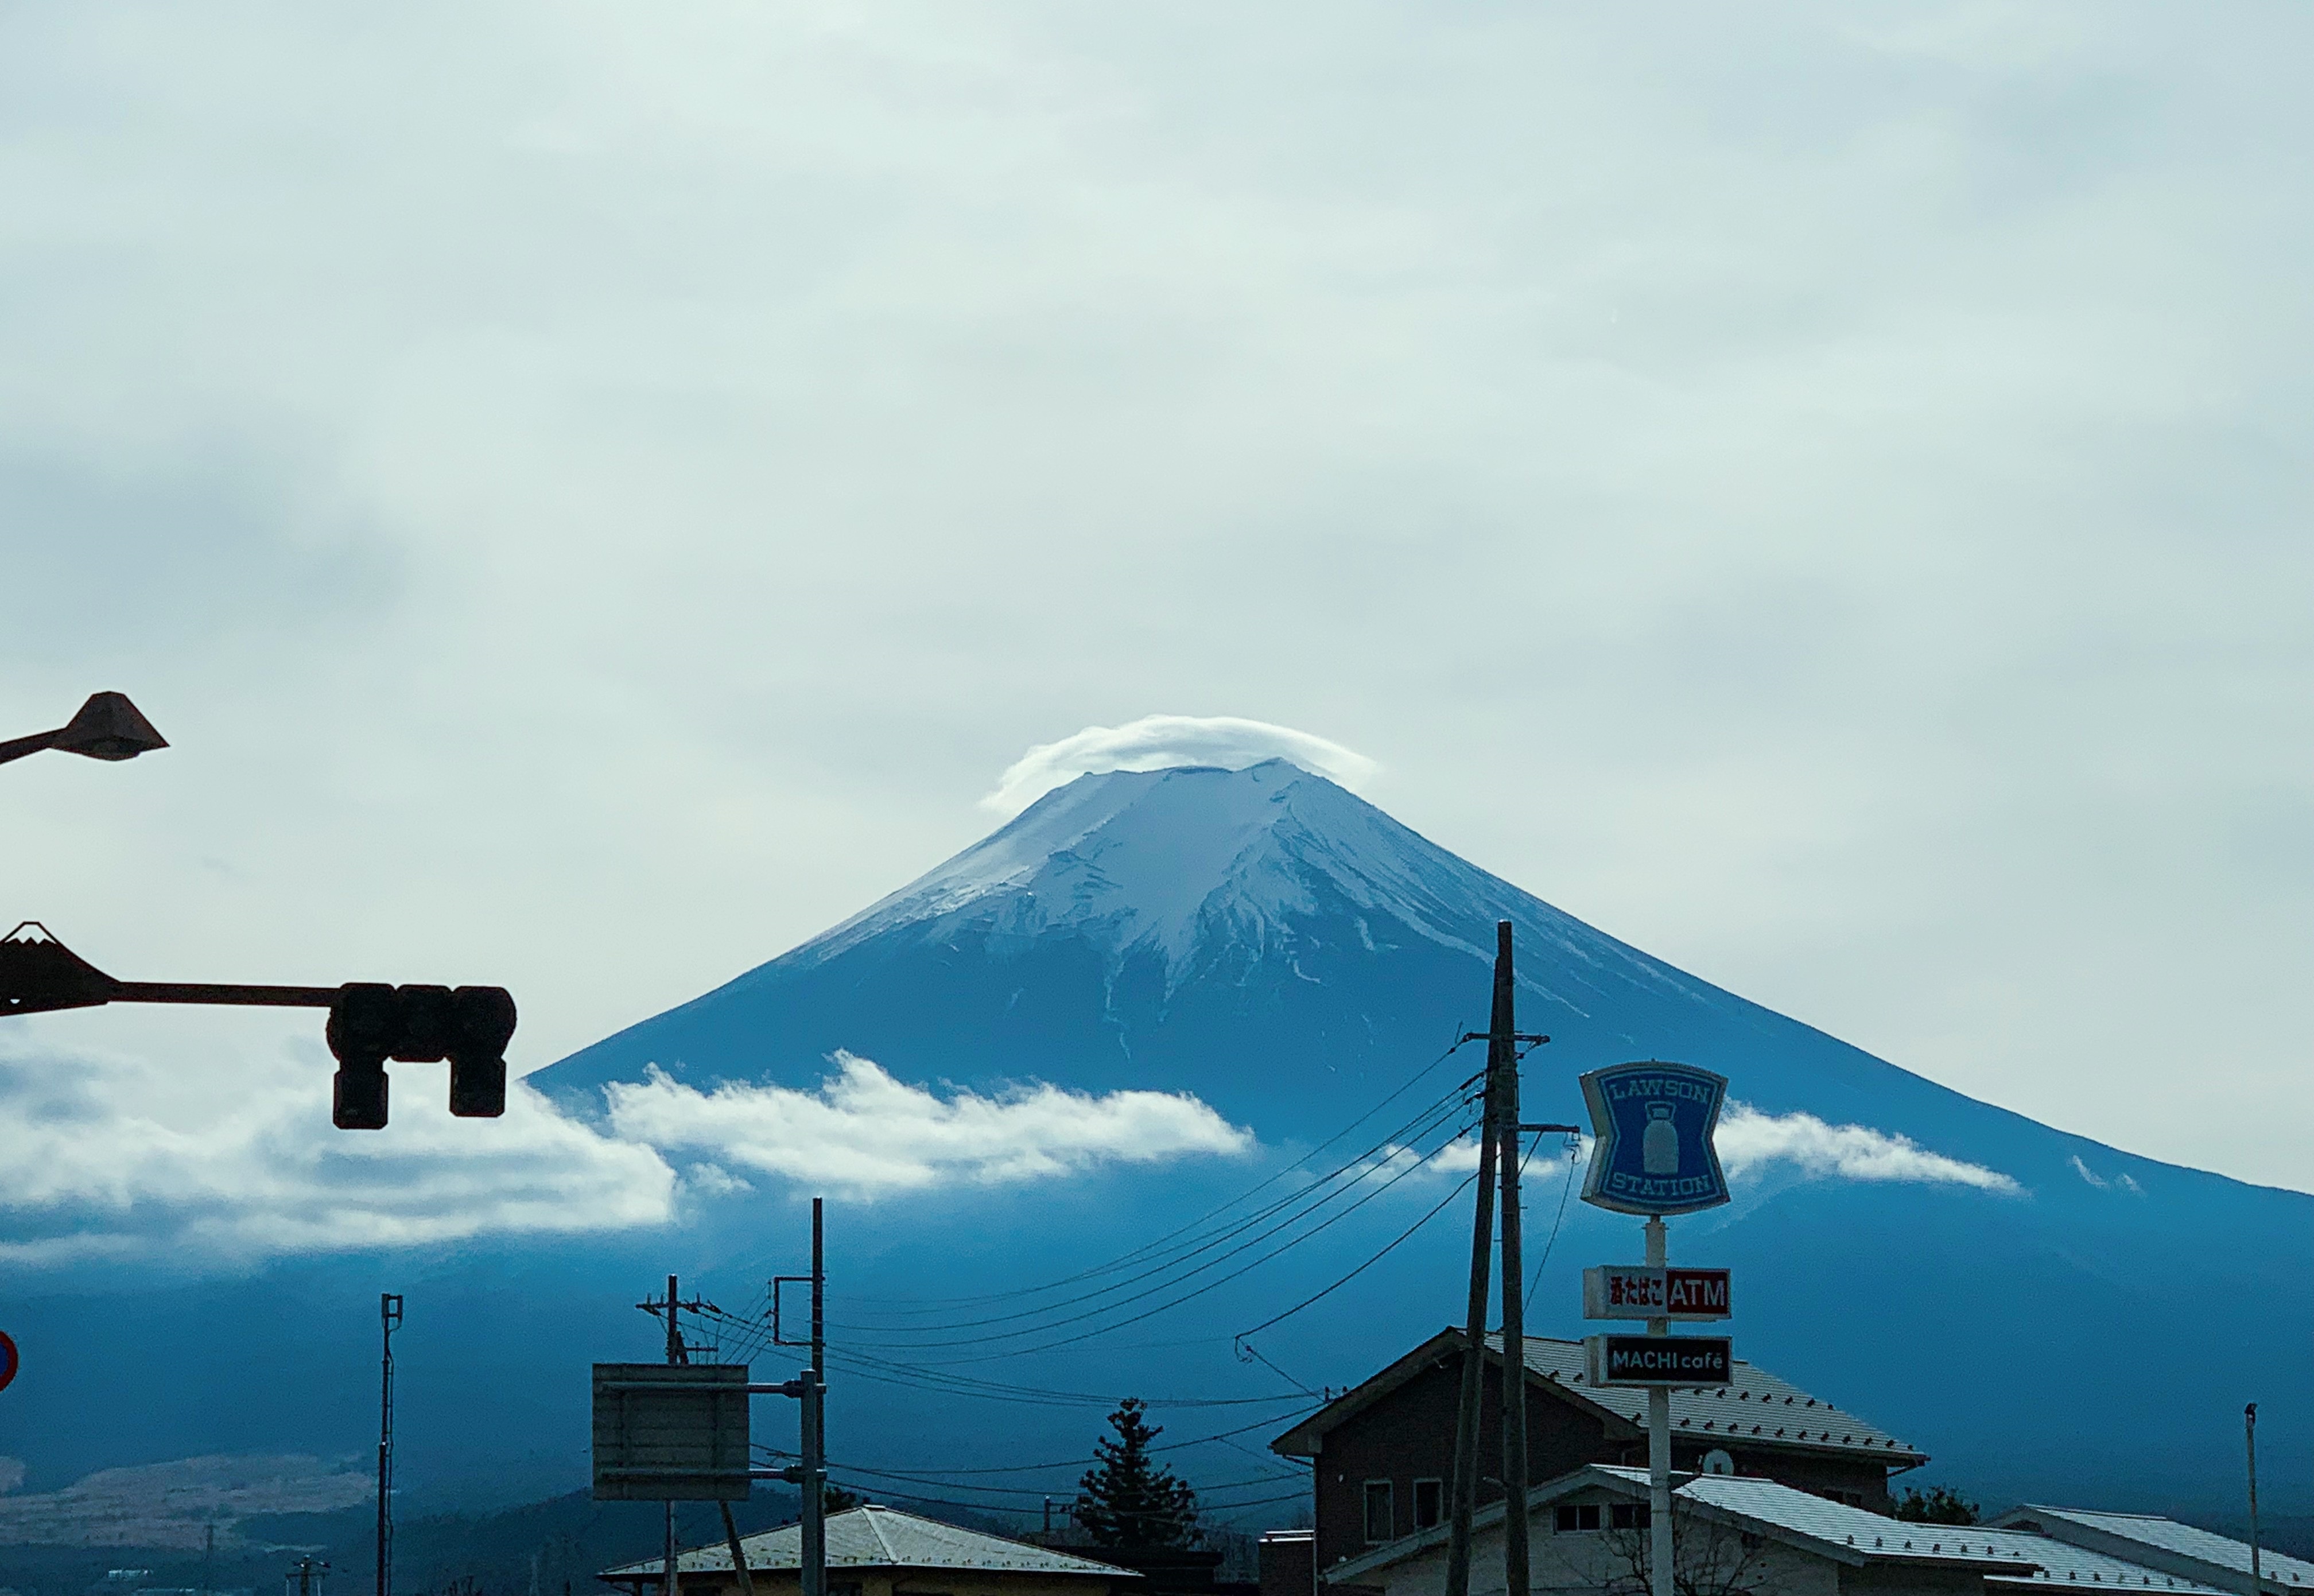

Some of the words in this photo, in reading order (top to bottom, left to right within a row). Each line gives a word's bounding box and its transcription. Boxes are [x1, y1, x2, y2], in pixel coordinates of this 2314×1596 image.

[1609, 1078, 1711, 1104] LAWSON
[1611, 1171, 1711, 1196] STATION
[1669, 1279, 1725, 1306] ATM
[1612, 1350, 1678, 1369] MACHI
[1681, 1352, 1723, 1369] café
